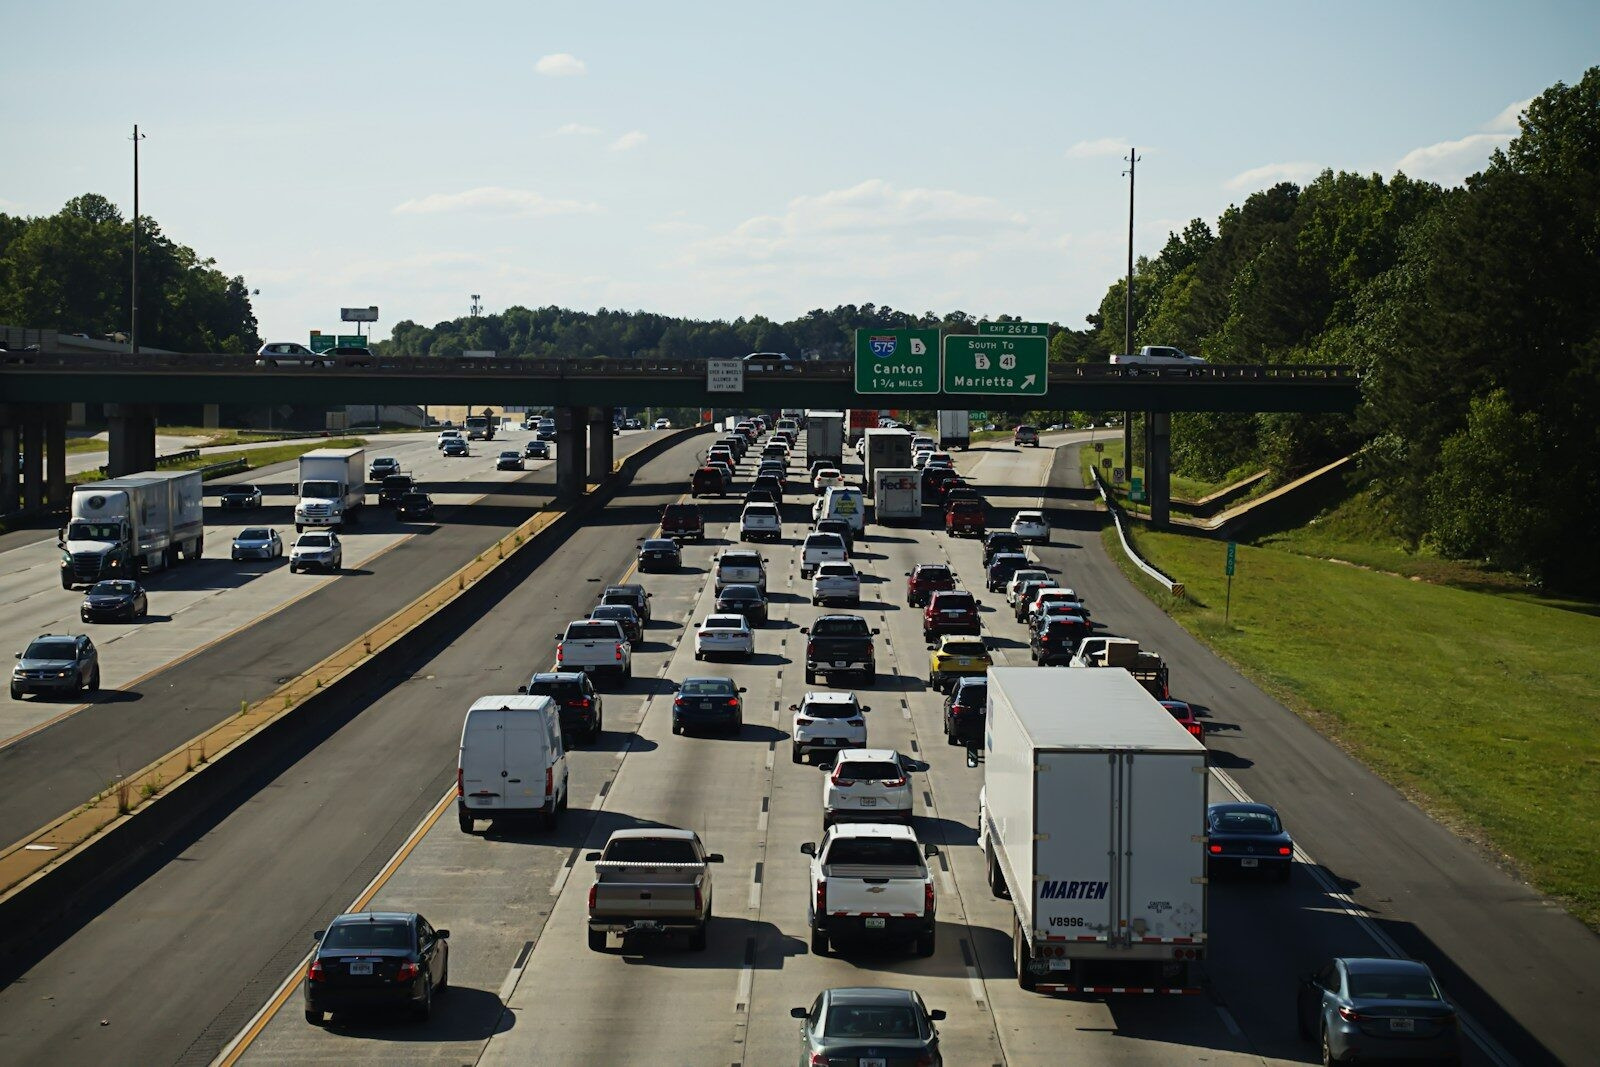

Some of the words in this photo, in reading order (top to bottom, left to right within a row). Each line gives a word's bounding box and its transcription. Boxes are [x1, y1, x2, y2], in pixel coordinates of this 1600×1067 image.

[1008, 325, 1028, 334] 267
[1031, 325, 1038, 334] B
[874, 342, 894, 353] 575
[915, 343, 921, 353] 5
[968, 340, 997, 349] SOUTH
[979, 358, 985, 368] 5
[1002, 357, 1013, 367] 41
[873, 363, 923, 375] Canton
[954, 376, 1014, 388] Marietta
[880, 478, 917, 489] FedEx
[1040, 880, 1109, 899] MARTEN
[1049, 916, 1084, 927] V8996
